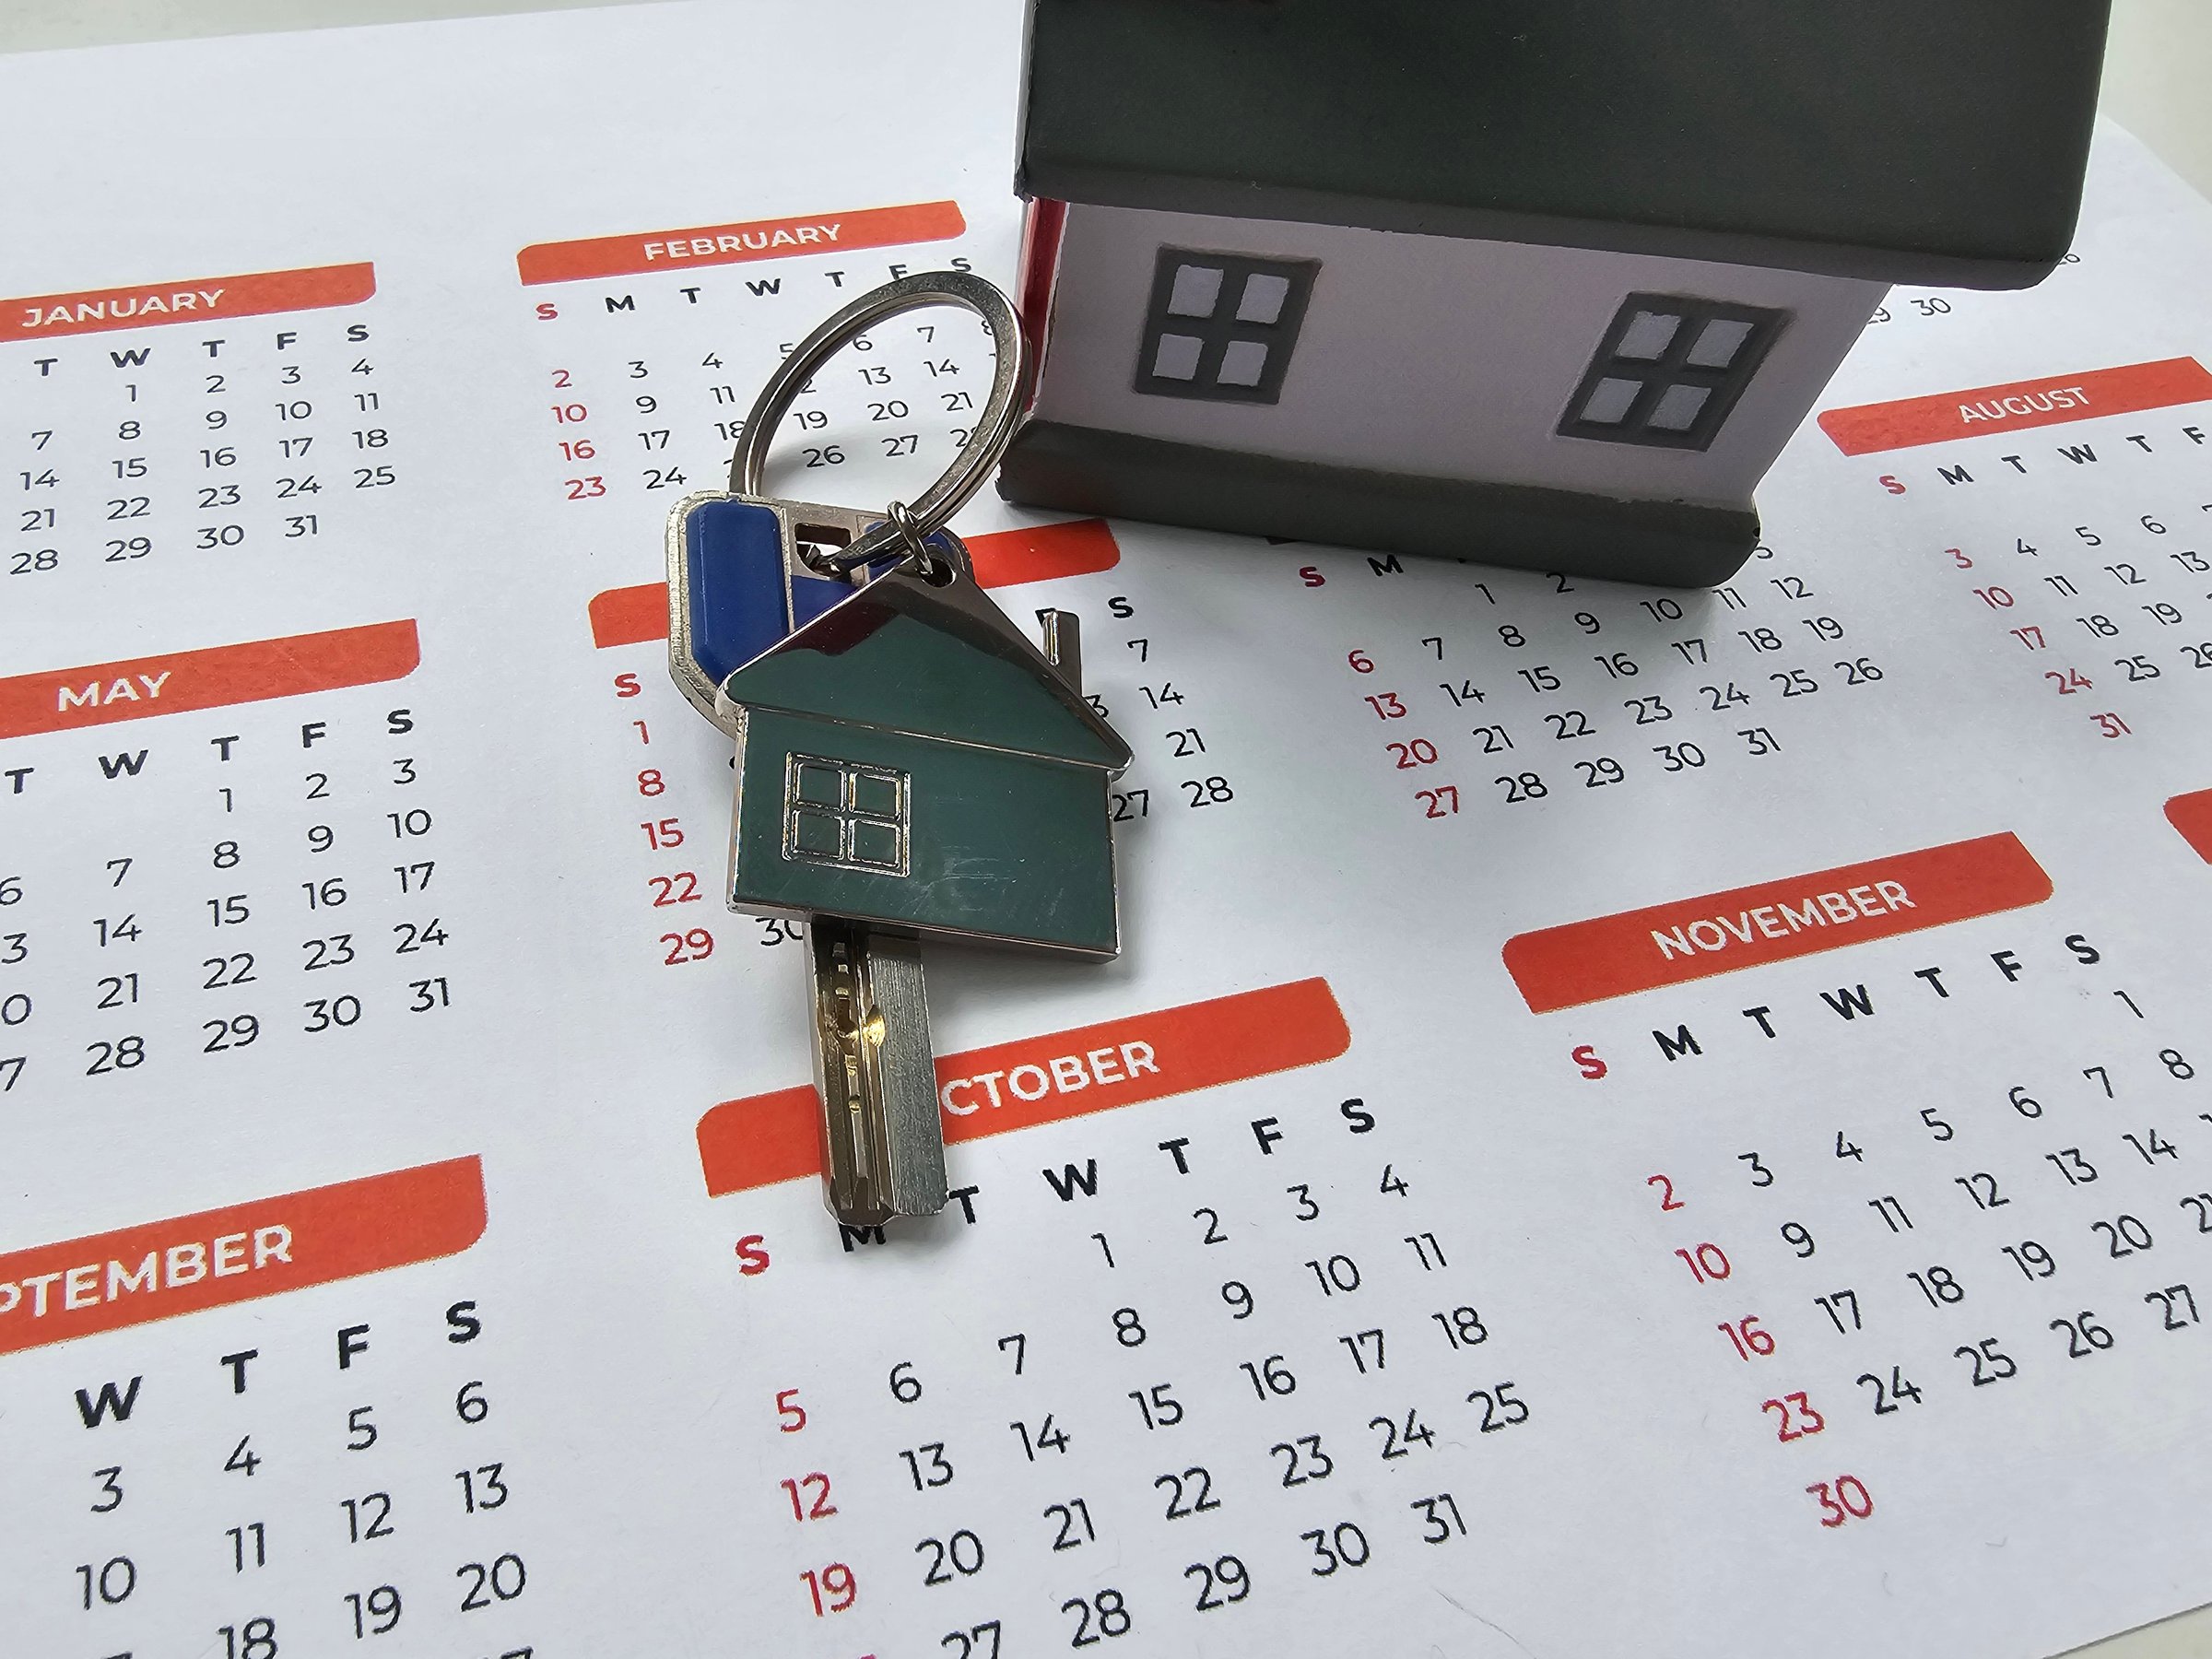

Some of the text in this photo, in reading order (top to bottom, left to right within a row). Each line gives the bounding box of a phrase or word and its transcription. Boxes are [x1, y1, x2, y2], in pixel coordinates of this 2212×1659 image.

[643, 223, 841, 261] FEBRUARY
[22, 288, 225, 327] JANUARY
[536, 303, 558, 320] S
[606, 295, 635, 312] M
[680, 288, 700, 303] T
[746, 278, 781, 296] W
[825, 272, 844, 287] T
[1911, 298, 1951, 315] 30
[34, 324, 369, 376] T W T F S
[126, 359, 373, 402] 1 2 3 4
[552, 326, 934, 388] 2 3 4 7
[31, 393, 378, 450] 7 8 9 10 11
[551, 359, 959, 423] 10 9 11 13 14
[1959, 387, 2089, 424] AUGUST
[1879, 427, 2205, 494] S M T W T F
[21, 465, 395, 531] 21 22 23 24 25
[1300, 557, 1404, 587] S M
[1945, 515, 2166, 569] 3 4 5 6
[1475, 572, 1574, 604] 1 2
[1972, 551, 2210, 610] 10 11 12 13
[615, 597, 1134, 697] S S
[1348, 577, 1814, 673] 6 7 8 9 10 11 12
[57, 671, 172, 712] MAY
[633, 639, 1147, 744] 1 7
[2090, 713, 2132, 738] 31
[5, 710, 413, 794] T W T F S
[638, 683, 1184, 796] 8 14
[1415, 728, 1781, 818] 27 28 29 30 31
[219, 759, 416, 812] 1 2 3
[641, 728, 1206, 850] 15 21
[107, 809, 431, 887] 7 8 9 10
[649, 777, 1233, 908] 22 28
[660, 928, 713, 965] 29
[1651, 880, 1916, 959] NOVEMBER
[98, 918, 449, 1009] 21 22 23 24
[1571, 935, 2100, 1079] S M T W T F S
[2113, 991, 2144, 1018] 1
[939, 1041, 1160, 1116] CTOBER
[1648, 1049, 2194, 1211] 2 3 4 5 6 7 8
[735, 1099, 1375, 1277] S T W T F S
[1091, 1164, 1409, 1267] 1 2 3 4
[0, 1225, 293, 1319] PTEMBER
[75, 1300, 481, 1429] W T F S
[776, 1233, 1447, 1432] 5 6 7 8 9 10 11
[1762, 1285, 2199, 1442] 23 24 25 26 27
[91, 1382, 488, 1512] 3 4 5 6
[76, 1463, 508, 1610] 10 11 12 13
[1806, 1476, 1874, 1527] 30
